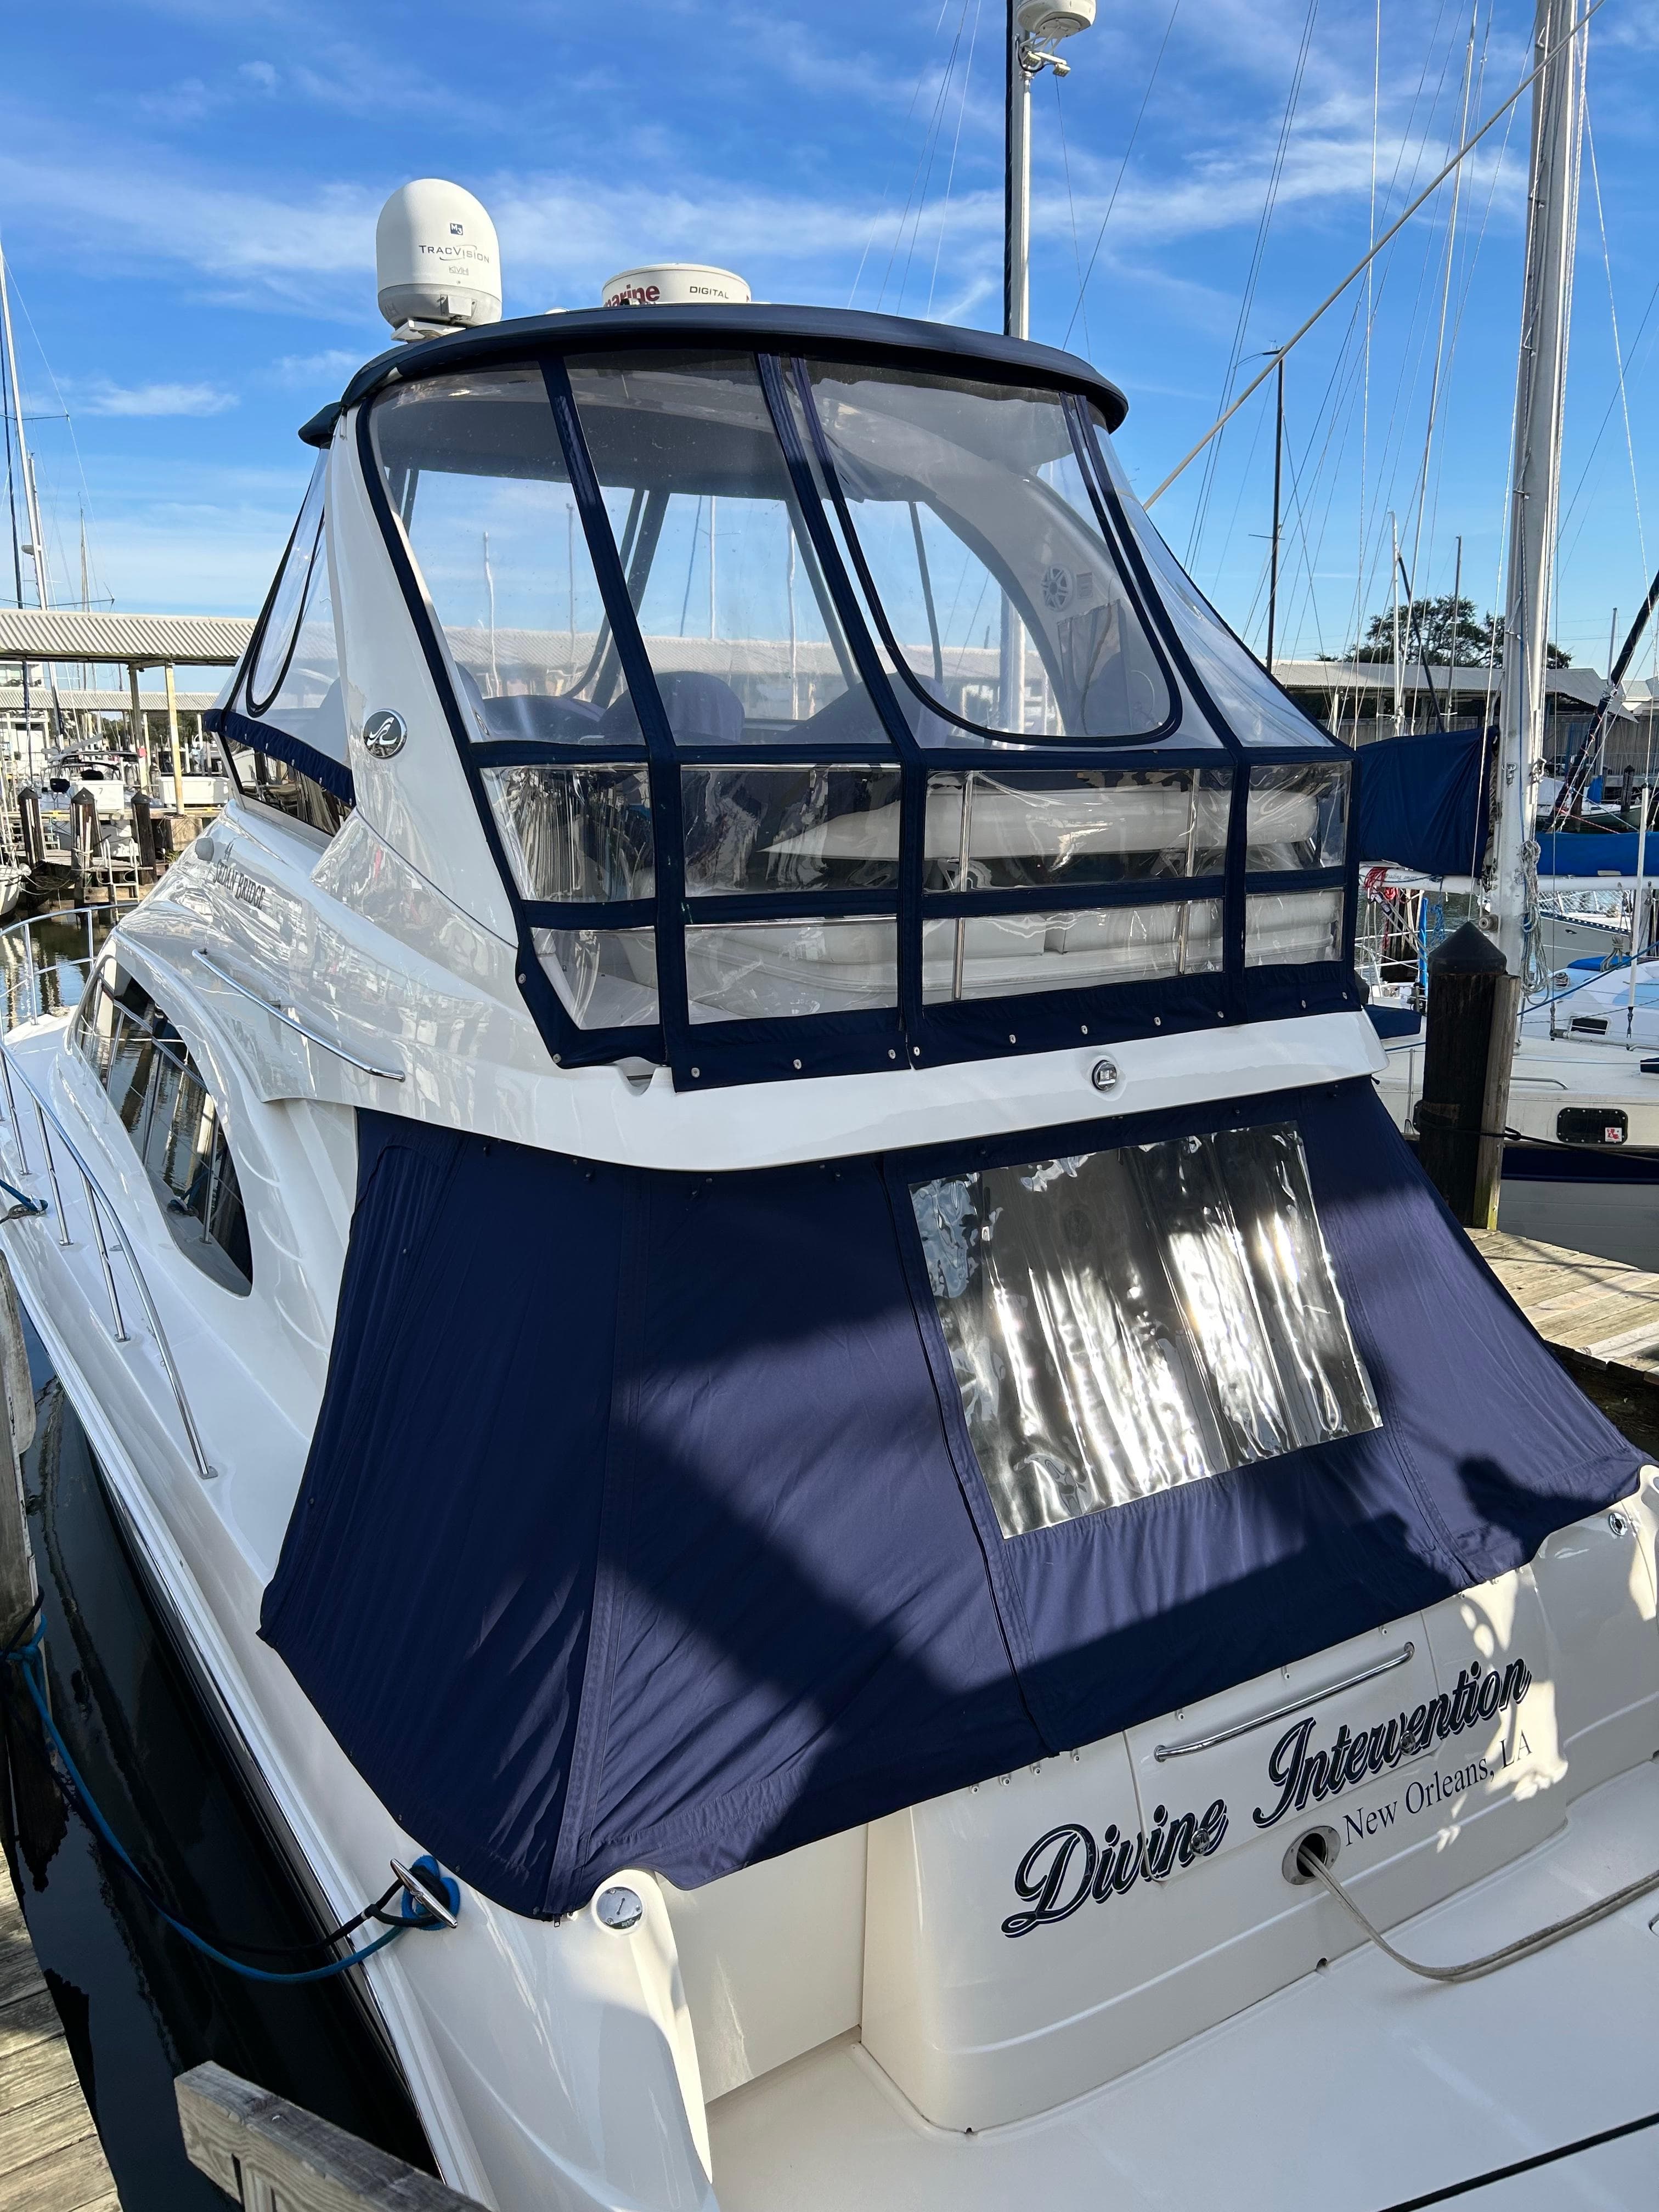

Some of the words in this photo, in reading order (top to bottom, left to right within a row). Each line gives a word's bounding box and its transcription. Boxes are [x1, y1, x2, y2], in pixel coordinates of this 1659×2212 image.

[451, 224, 462, 235] M3
[419, 245, 489, 263] TRACVISION
[690, 286, 729, 299] DIGITAL
[213, 859, 238, 891] SEDAN
[235, 873, 266, 910] BRIDGE
[1001, 1799, 1229, 1938] Divine
[1252, 1658, 1532, 1829] Intervention
[1342, 1801, 1398, 1847] New
[1406, 1758, 1494, 1814] Orleans,
[1499, 1729, 1532, 1770] LA
